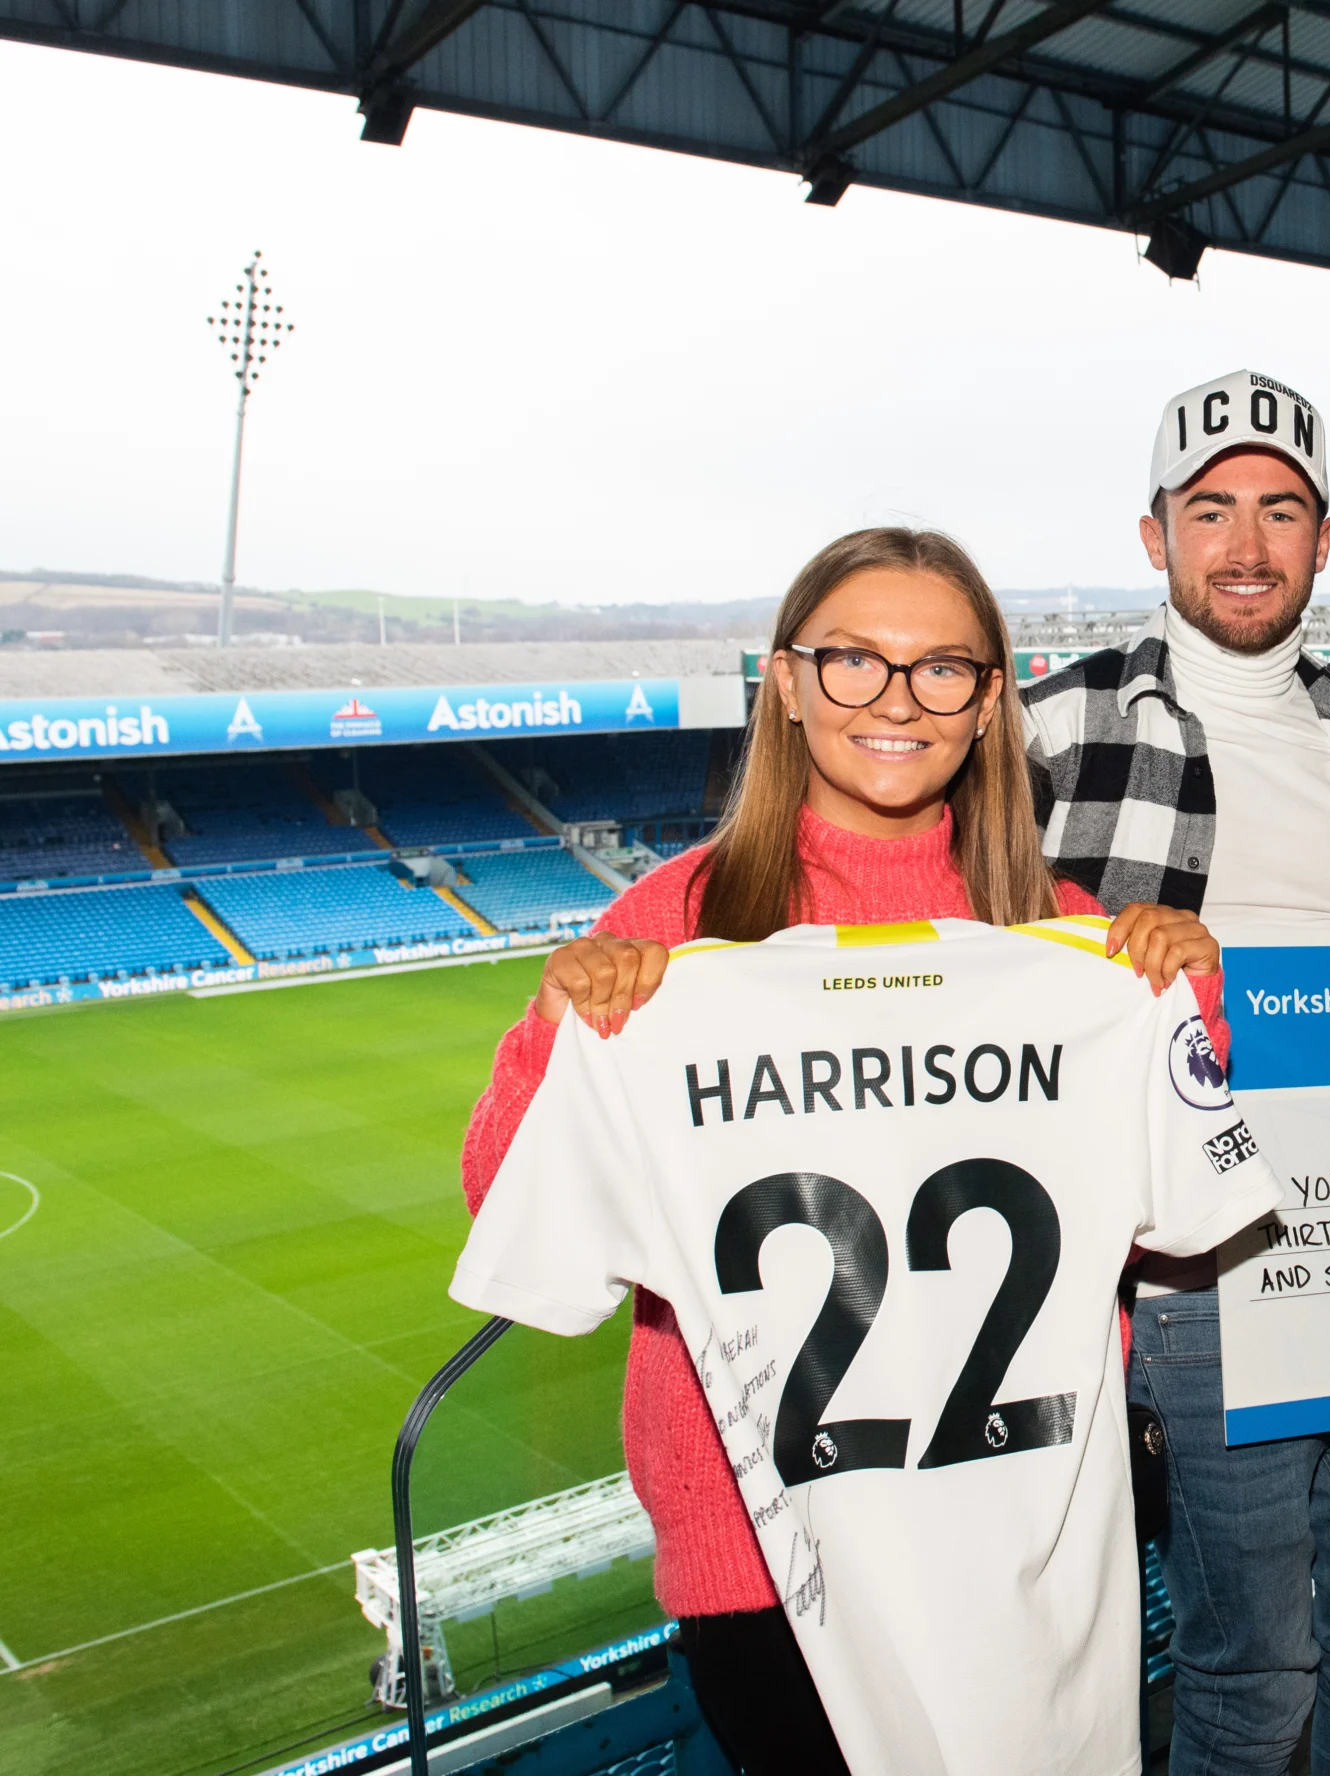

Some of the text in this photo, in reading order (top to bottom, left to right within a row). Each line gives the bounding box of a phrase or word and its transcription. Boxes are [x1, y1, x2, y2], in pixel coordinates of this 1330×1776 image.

[1250, 374, 1313, 413] DSQUARED2
[1178, 389, 1314, 458] ICON
[427, 690, 582, 732] Astonish
[98, 975, 188, 999] Yorkshire
[191, 965, 255, 988] Cancer
[823, 974, 943, 991] LEEDS UNITED
[685, 1043, 1063, 1128] HARRISON
[1260, 1265, 1311, 1293] AND
[714, 1157, 1078, 1488] 22
[371, 1714, 445, 1753] Caner
[450, 1682, 527, 1724] Research
[579, 1630, 661, 1672] Yorkshire
